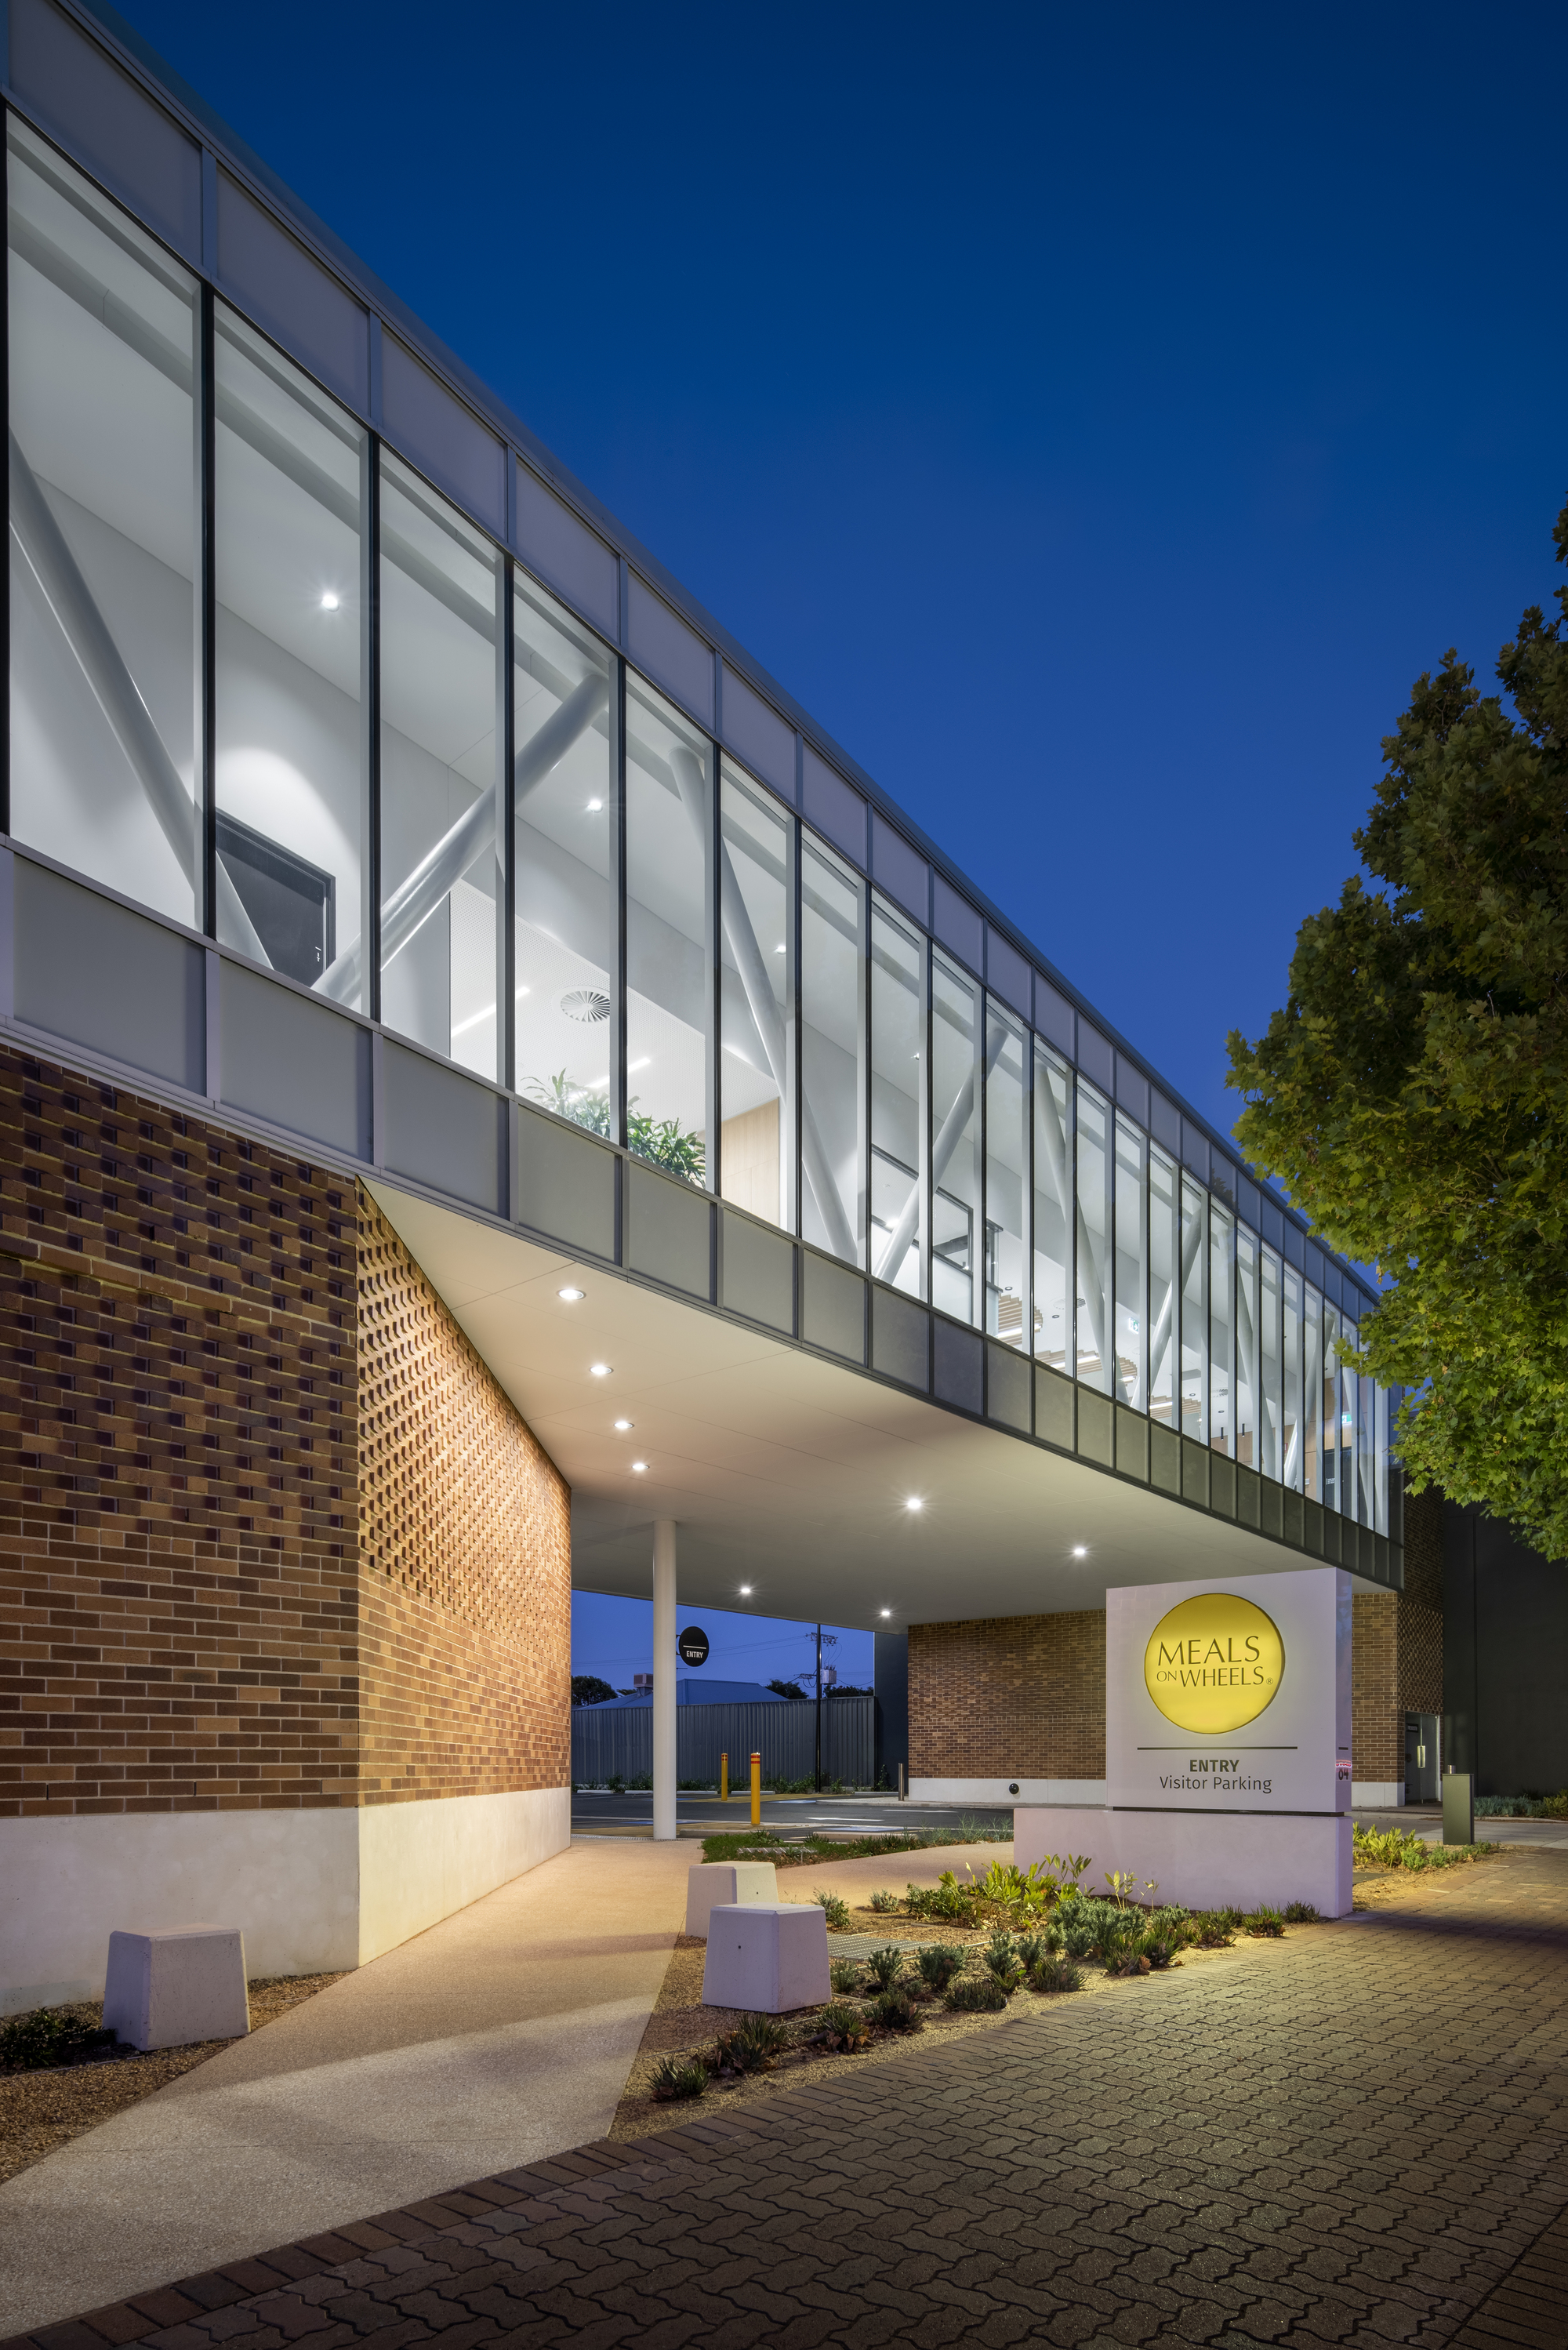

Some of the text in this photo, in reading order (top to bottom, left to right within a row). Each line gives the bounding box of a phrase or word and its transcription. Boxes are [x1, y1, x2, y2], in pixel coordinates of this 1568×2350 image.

[1158, 1636, 1260, 1666] MEALS
[1156, 1670, 1177, 1682] ON
[1189, 1759, 1240, 1773] ENTRY
[1160, 1774, 1272, 1794] Visitor Parking
